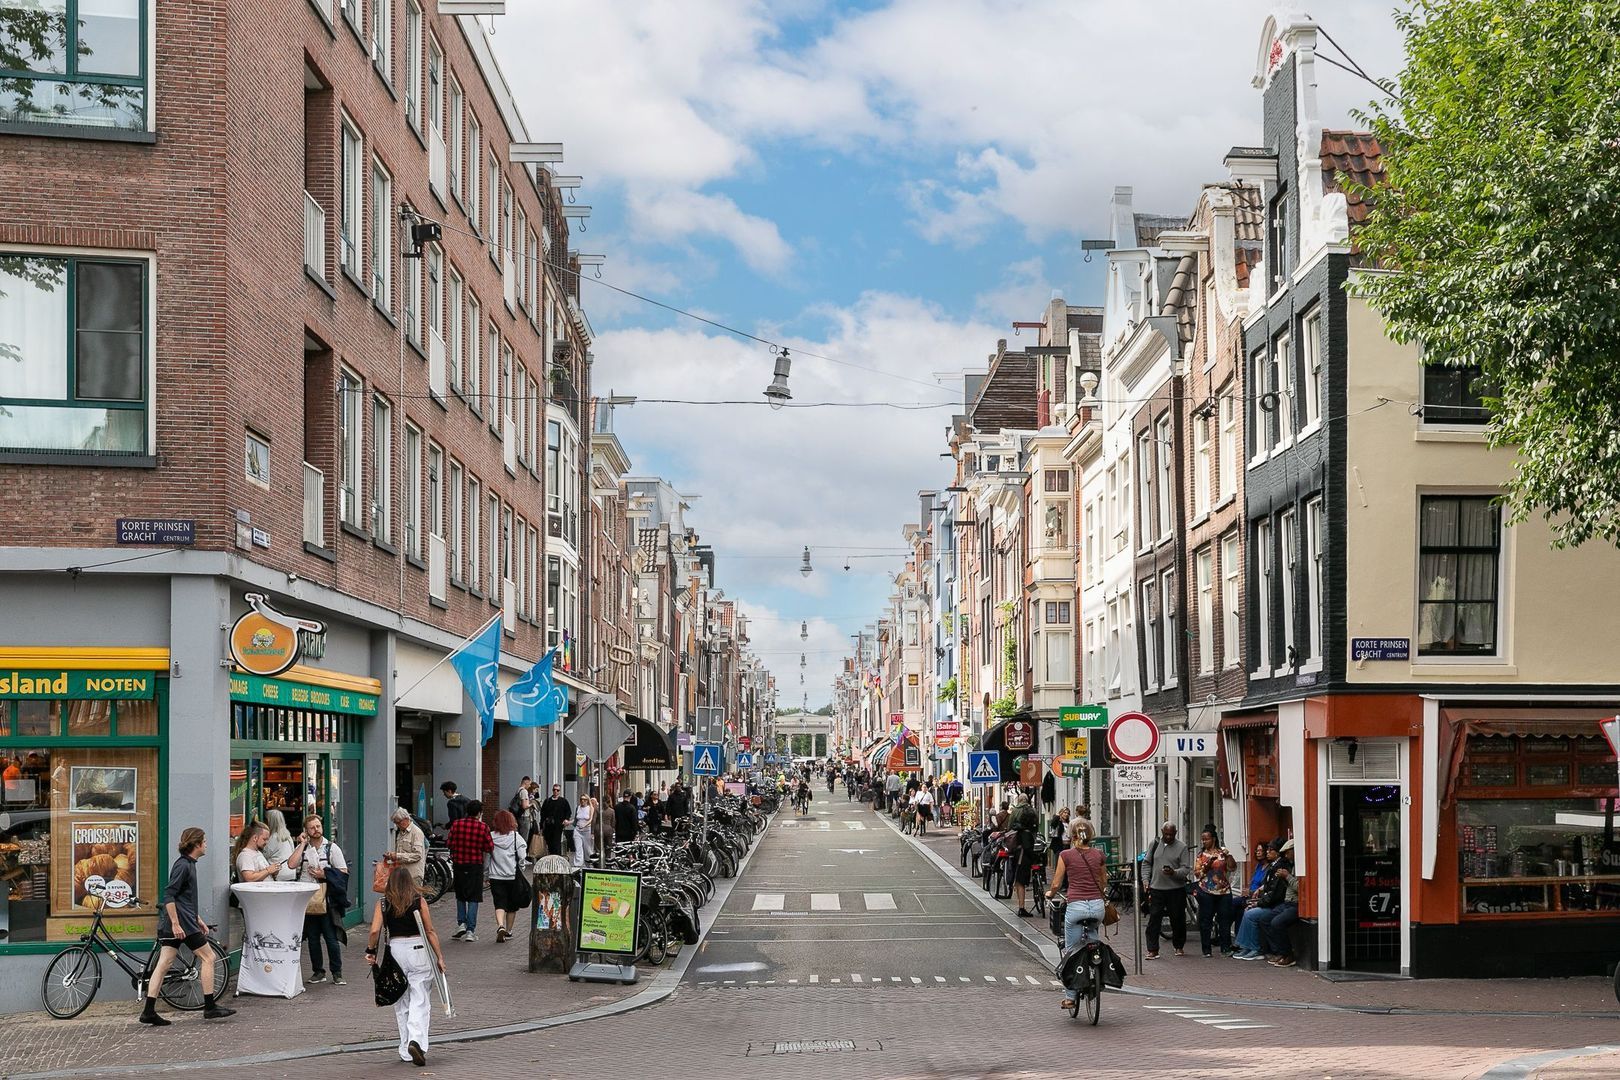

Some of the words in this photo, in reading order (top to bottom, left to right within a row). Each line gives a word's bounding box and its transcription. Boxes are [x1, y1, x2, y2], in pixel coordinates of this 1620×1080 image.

[121, 521, 150, 531] KORTE
[153, 521, 190, 531] PRINSEN
[121, 532, 157, 541] GRACHT
[1355, 640, 1377, 649] KORTE
[1380, 640, 1408, 649] PRINSEN
[1355, 650, 1382, 658] GRACHT
[86, 678, 146, 692] NOTEN
[262, 683, 279, 699] CHEESE
[358, 698, 376, 711] FROMAGE
[1062, 712, 1101, 721] SUBWAY
[1177, 738, 1205, 751] VIS
[74, 828, 136, 844] CROISSANTS
[1602, 849, 1620, 866] Su
